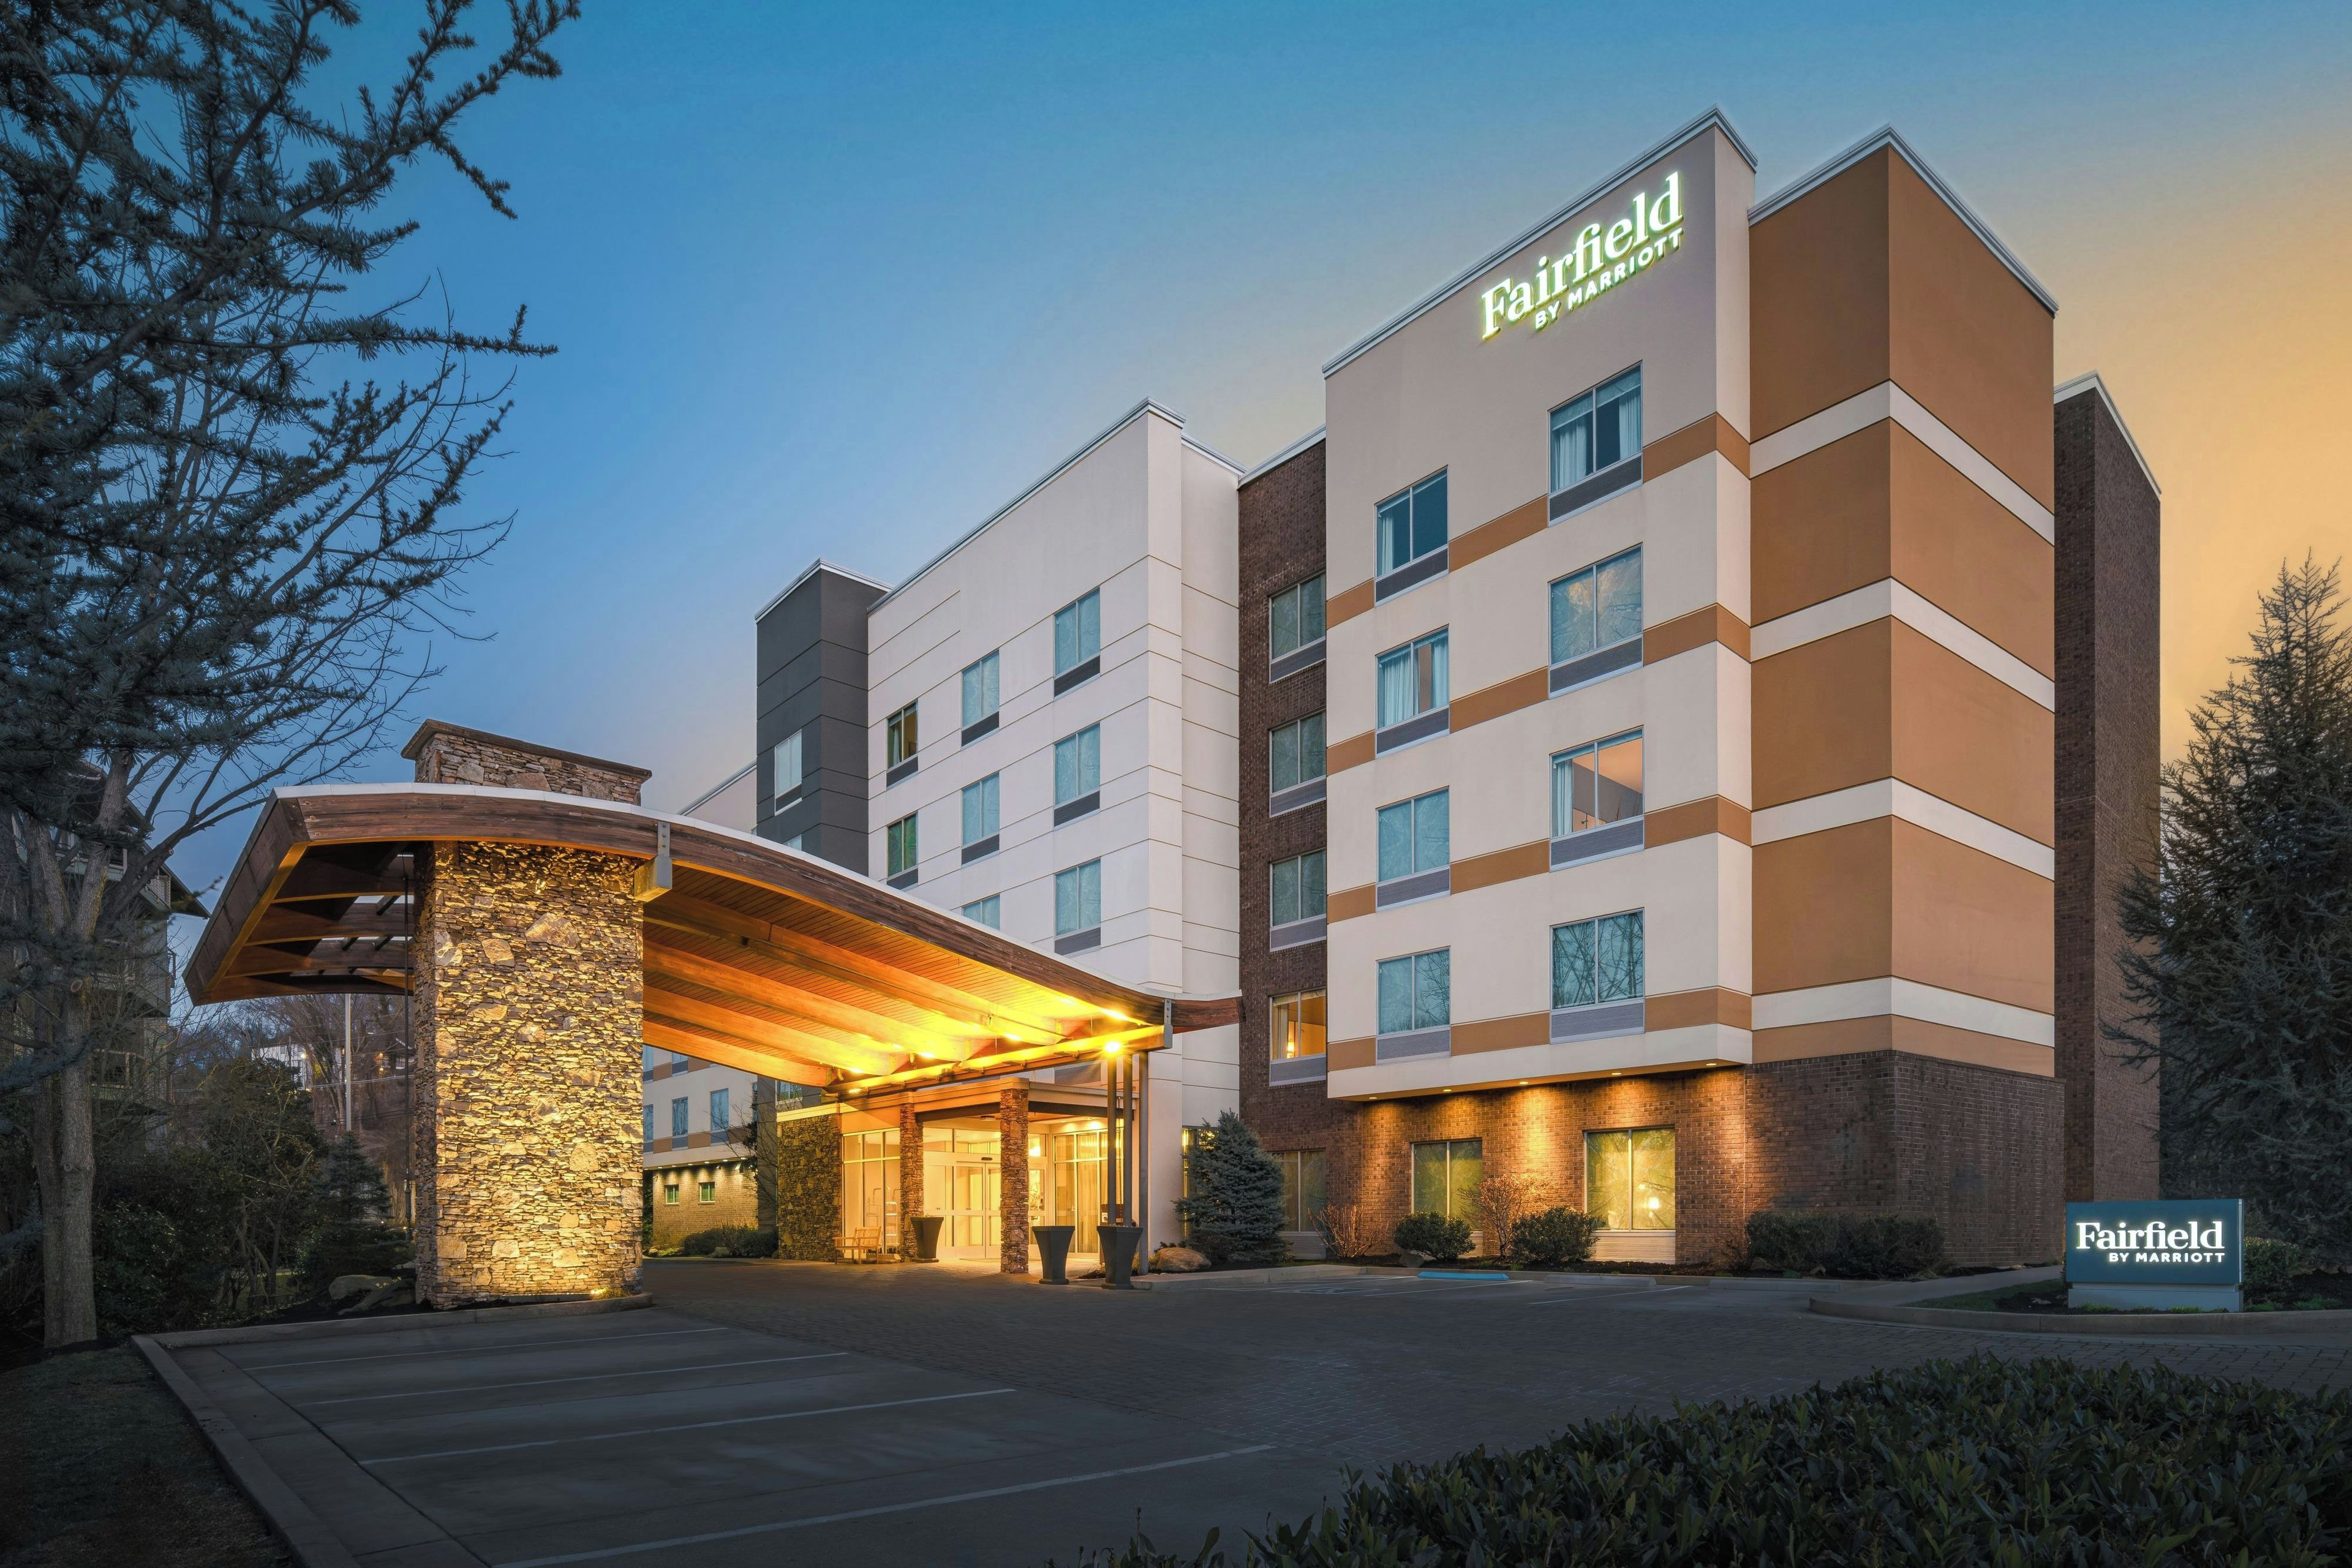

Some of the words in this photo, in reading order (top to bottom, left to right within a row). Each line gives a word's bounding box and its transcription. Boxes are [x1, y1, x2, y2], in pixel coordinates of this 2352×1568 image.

[1481, 171, 1684, 340] Fairfield
[1535, 301, 1562, 331] BY
[1568, 227, 1684, 311] MARRIOTT
[2076, 1221, 2225, 1250] Fairfield
[2109, 1253, 2129, 1262] BY
[2136, 1253, 2225, 1262] MARRIOTT
